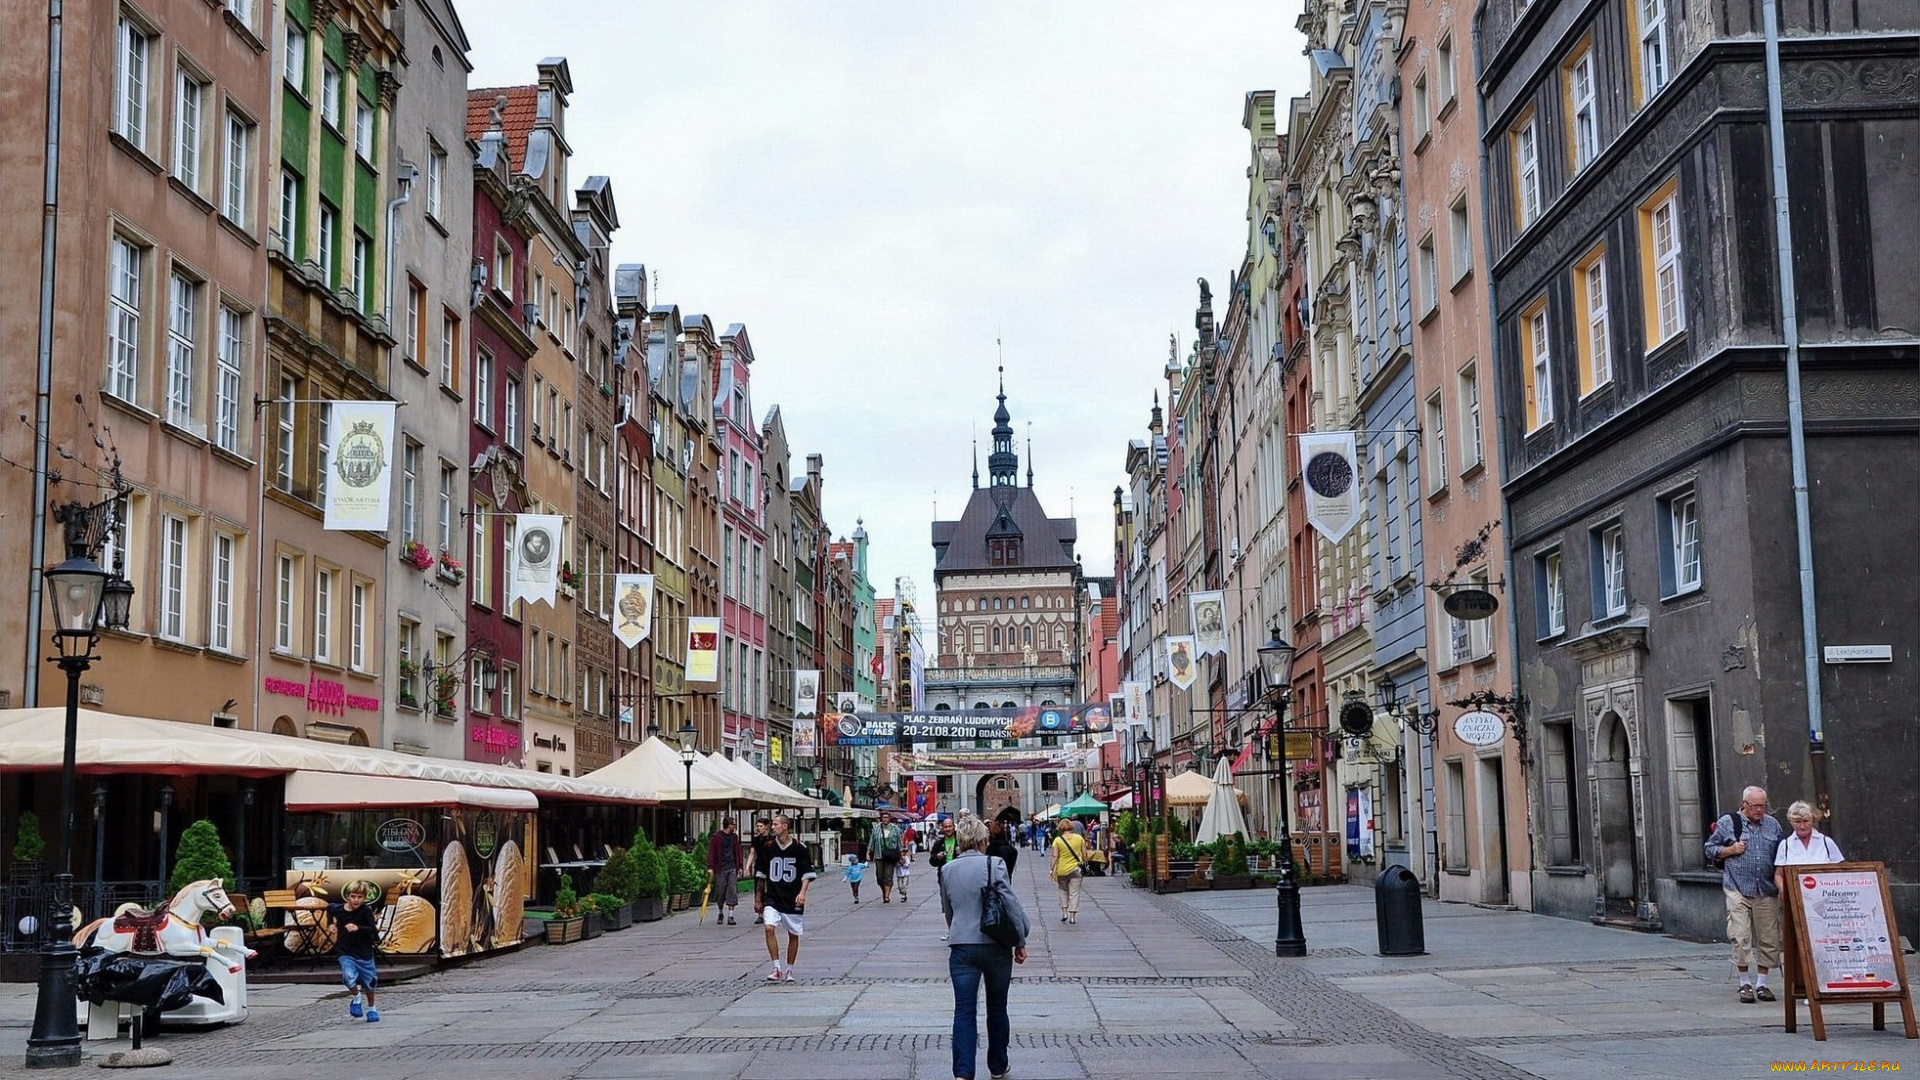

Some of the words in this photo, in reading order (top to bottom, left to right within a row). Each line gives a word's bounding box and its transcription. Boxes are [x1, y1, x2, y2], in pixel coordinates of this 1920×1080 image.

[903, 714, 925, 723] PLAC
[928, 714, 962, 724] ZEBRAŃ
[964, 716, 1013, 726] LUDOWYCH
[866, 721, 897, 729] BALTIC
[1462, 724, 1495, 732] ZNACZKI
[862, 728, 894, 736] GAMES
[903, 726, 976, 737] 20-21.08.2010
[978, 728, 1013, 738] GDAŃSK
[1466, 732, 1497, 740] MONETY
[868, 736, 896, 744] FESTIVAL
[382, 826, 420, 837] ZIELONA
[770, 856, 796, 882] 05
[1822, 890, 1860, 898] Polecamy:
